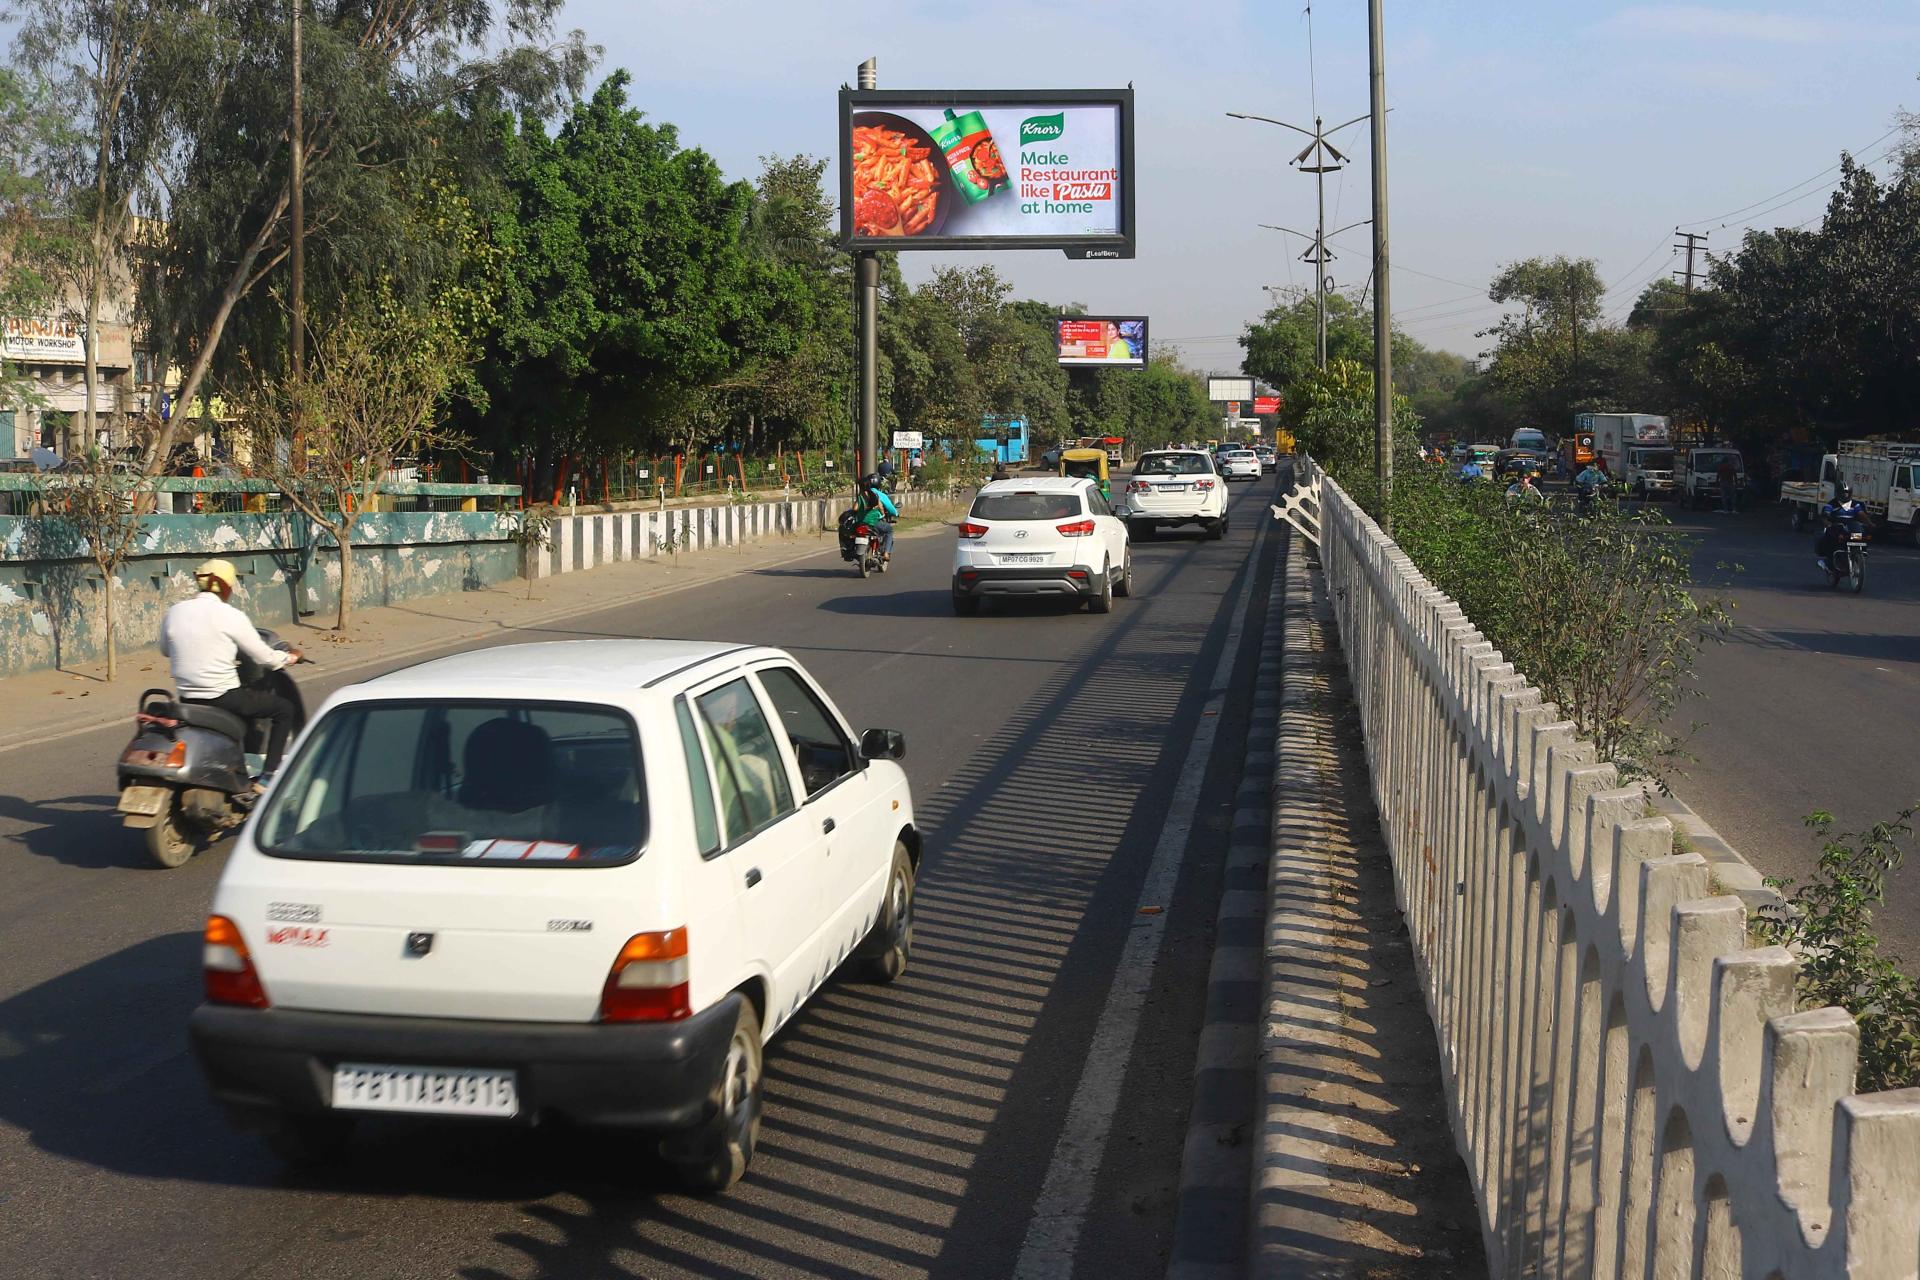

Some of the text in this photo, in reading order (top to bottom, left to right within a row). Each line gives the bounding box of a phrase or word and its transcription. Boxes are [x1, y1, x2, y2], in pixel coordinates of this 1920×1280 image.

[1021, 122, 1061, 135] Knorr
[940, 135, 962, 150] Knorr
[1020, 151, 1069, 165] Make
[1021, 168, 1119, 181] Restaurant
[1021, 181, 1108, 201] like Pasta
[1020, 200, 1094, 214] at home
[9, 316, 76, 339] PUNJAB
[9, 336, 76, 349] MOTOR WORKSHOP
